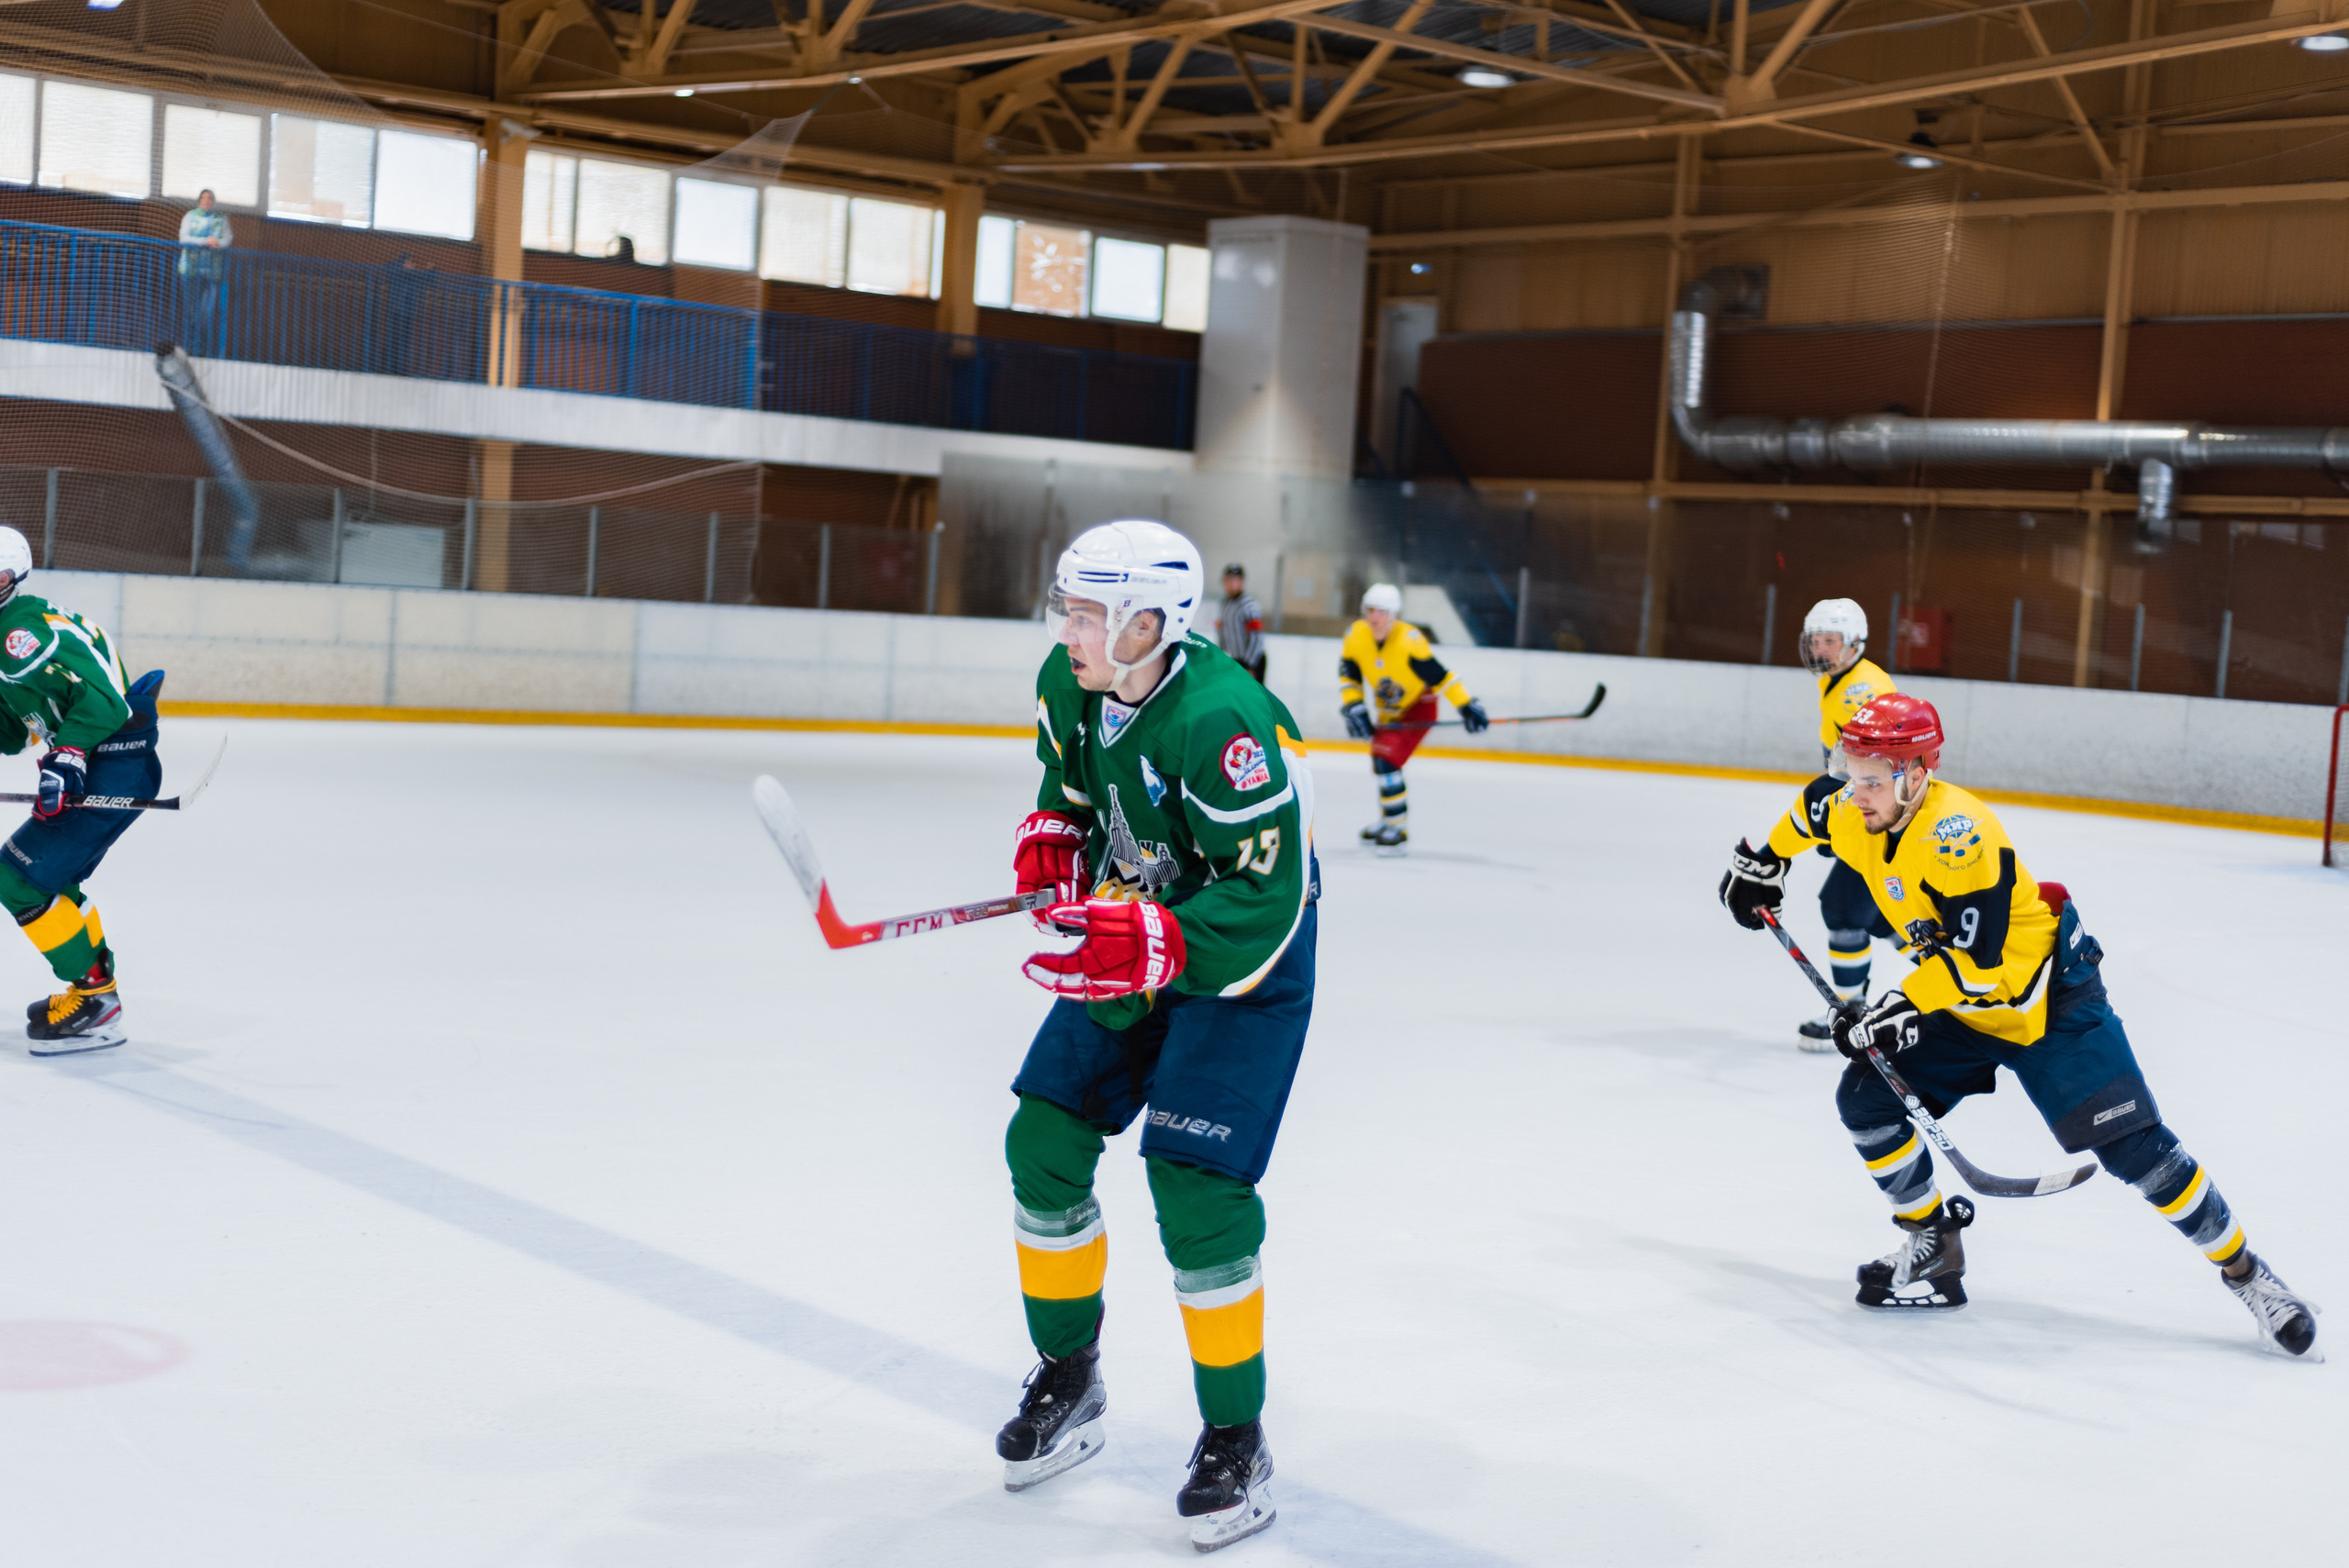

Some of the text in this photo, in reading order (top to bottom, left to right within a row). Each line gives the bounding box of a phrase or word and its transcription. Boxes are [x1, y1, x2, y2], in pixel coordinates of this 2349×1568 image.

[96, 739, 147, 752] BAUER
[82, 795, 135, 808] BAUER
[1016, 818, 1085, 844] AUER
[1935, 818, 1974, 844] МИР
[1732, 853, 1776, 876] CM
[1952, 906, 1980, 949] 9
[1138, 901, 1166, 989] BAUER
